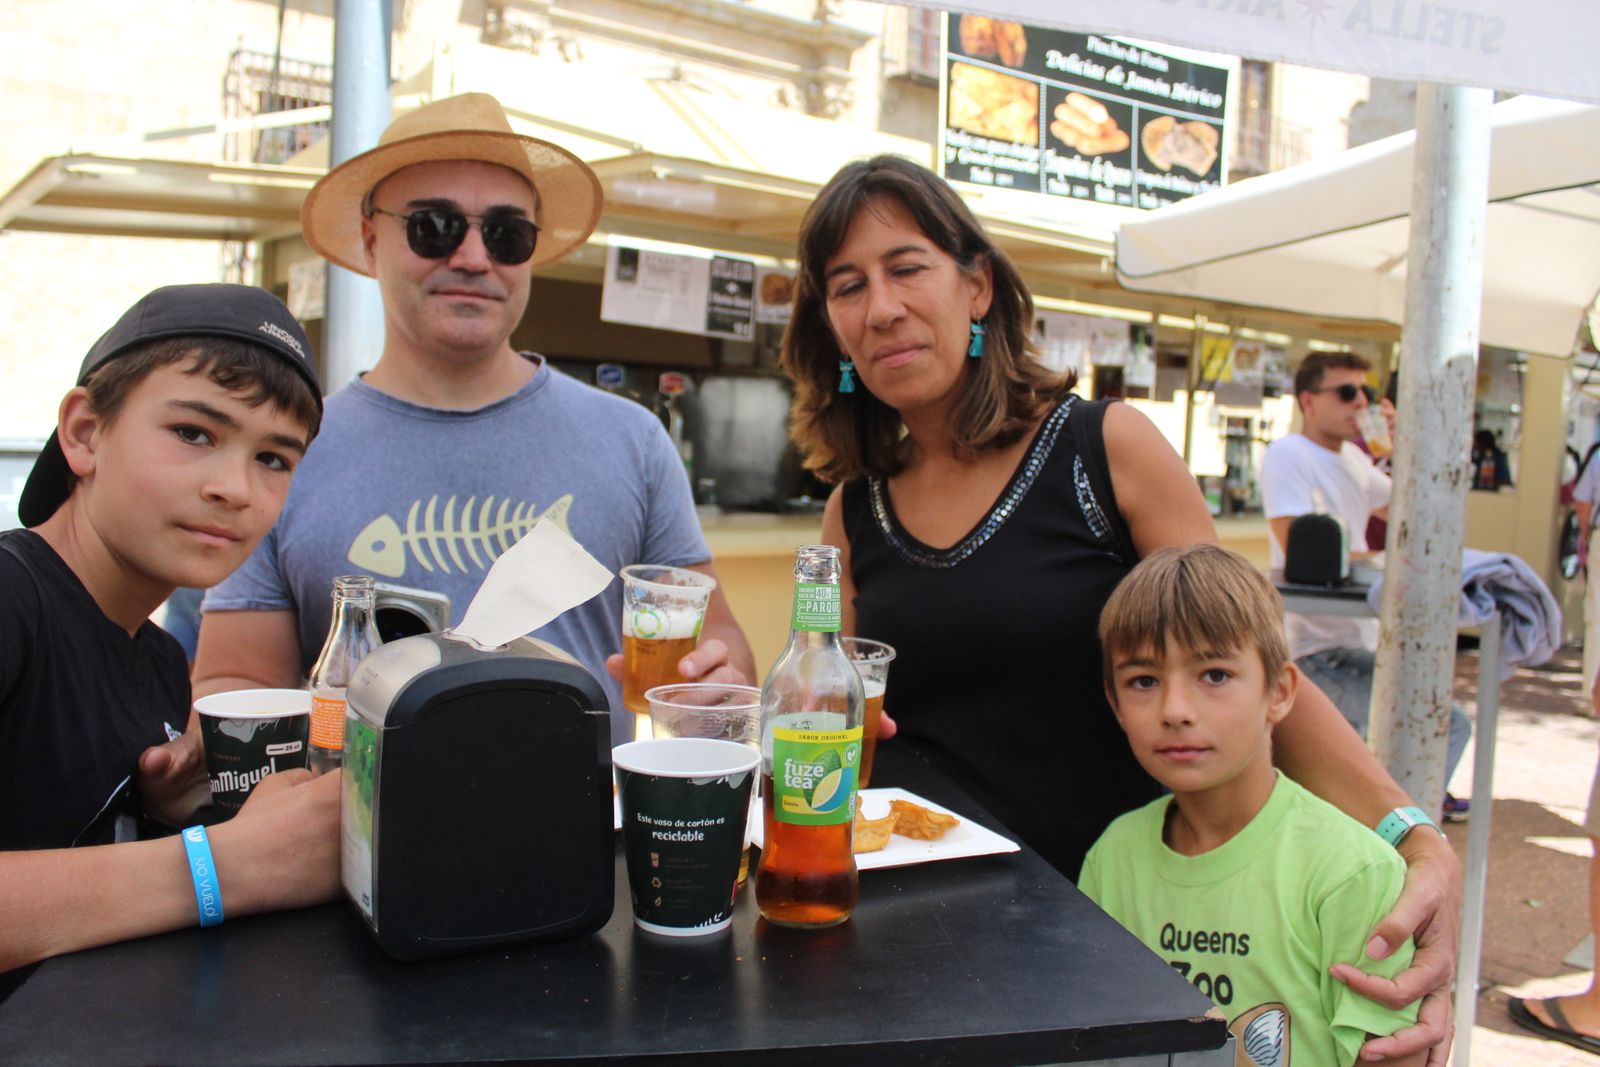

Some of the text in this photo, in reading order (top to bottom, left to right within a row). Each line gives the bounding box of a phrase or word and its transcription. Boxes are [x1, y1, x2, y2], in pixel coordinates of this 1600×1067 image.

[1105, 65, 1125, 85] de
[784, 758, 824, 778] fuze
[784, 773, 813, 789] tea
[637, 812, 725, 828] Este vaso de cartón es
[652, 830, 705, 842] reciclable
[1160, 922, 1250, 956] Queens
